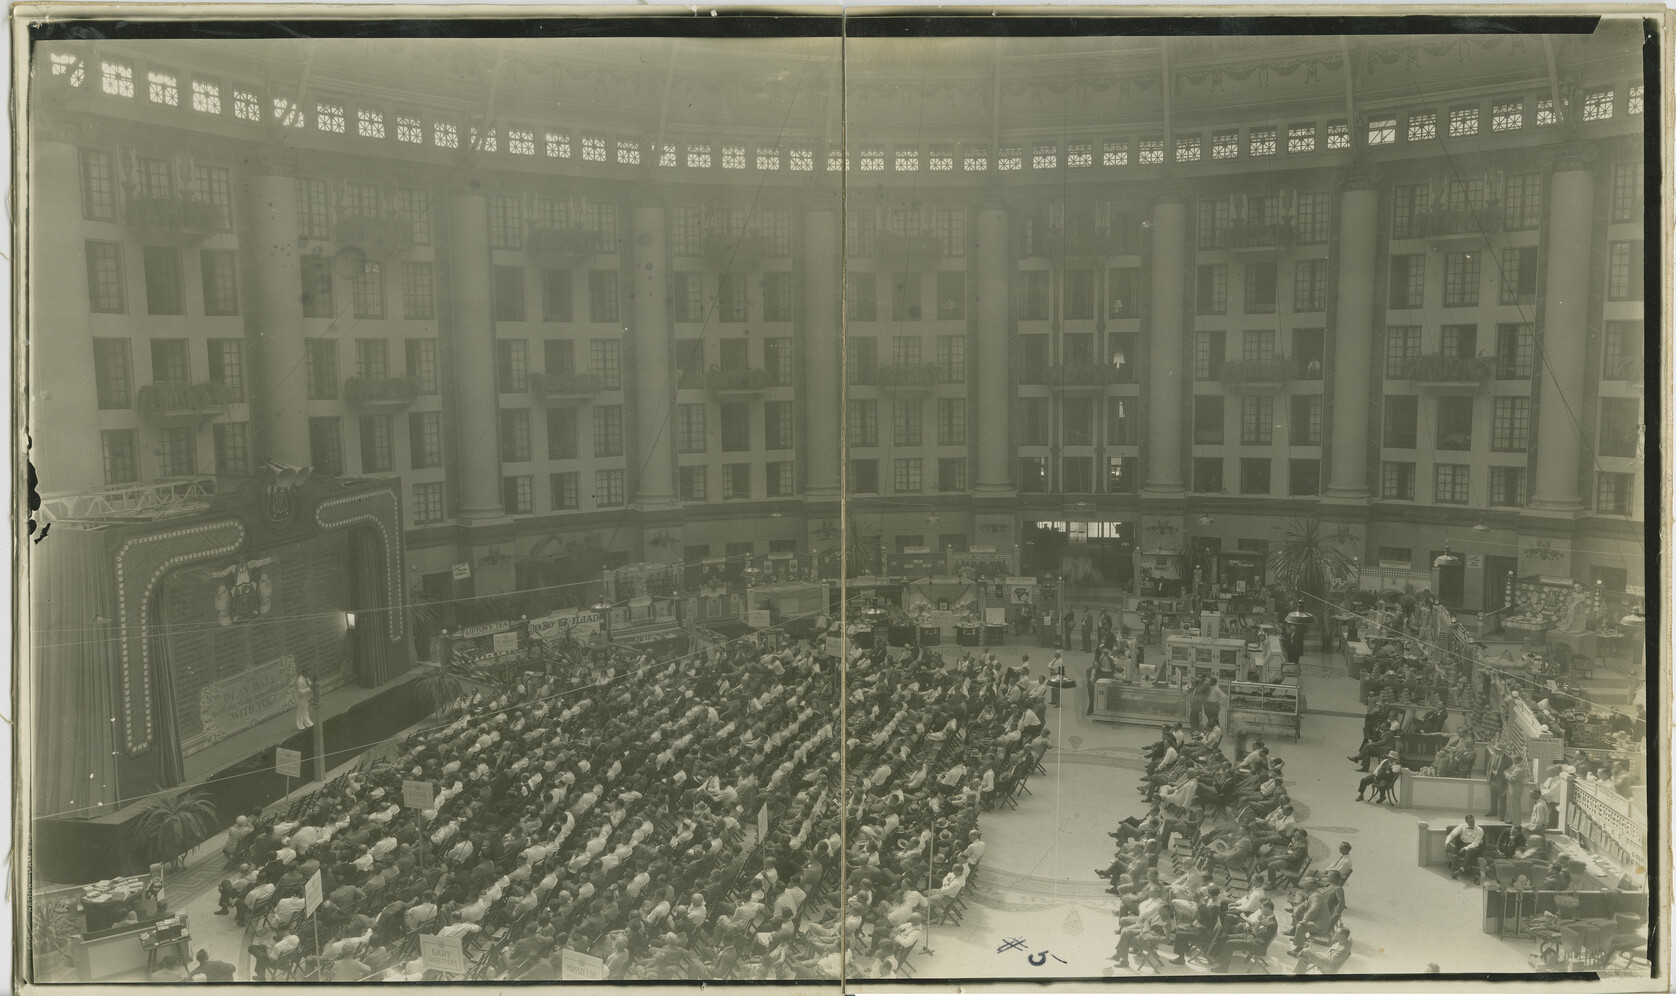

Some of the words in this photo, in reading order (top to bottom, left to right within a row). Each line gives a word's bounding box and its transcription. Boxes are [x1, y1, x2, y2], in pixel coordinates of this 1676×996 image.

[572, 614, 600, 626] ILIAD
[224, 686, 249, 703] PLAY
[253, 675, 276, 691] BALL
[231, 703, 254, 720] WITH
[431, 947, 452, 958] GARY
